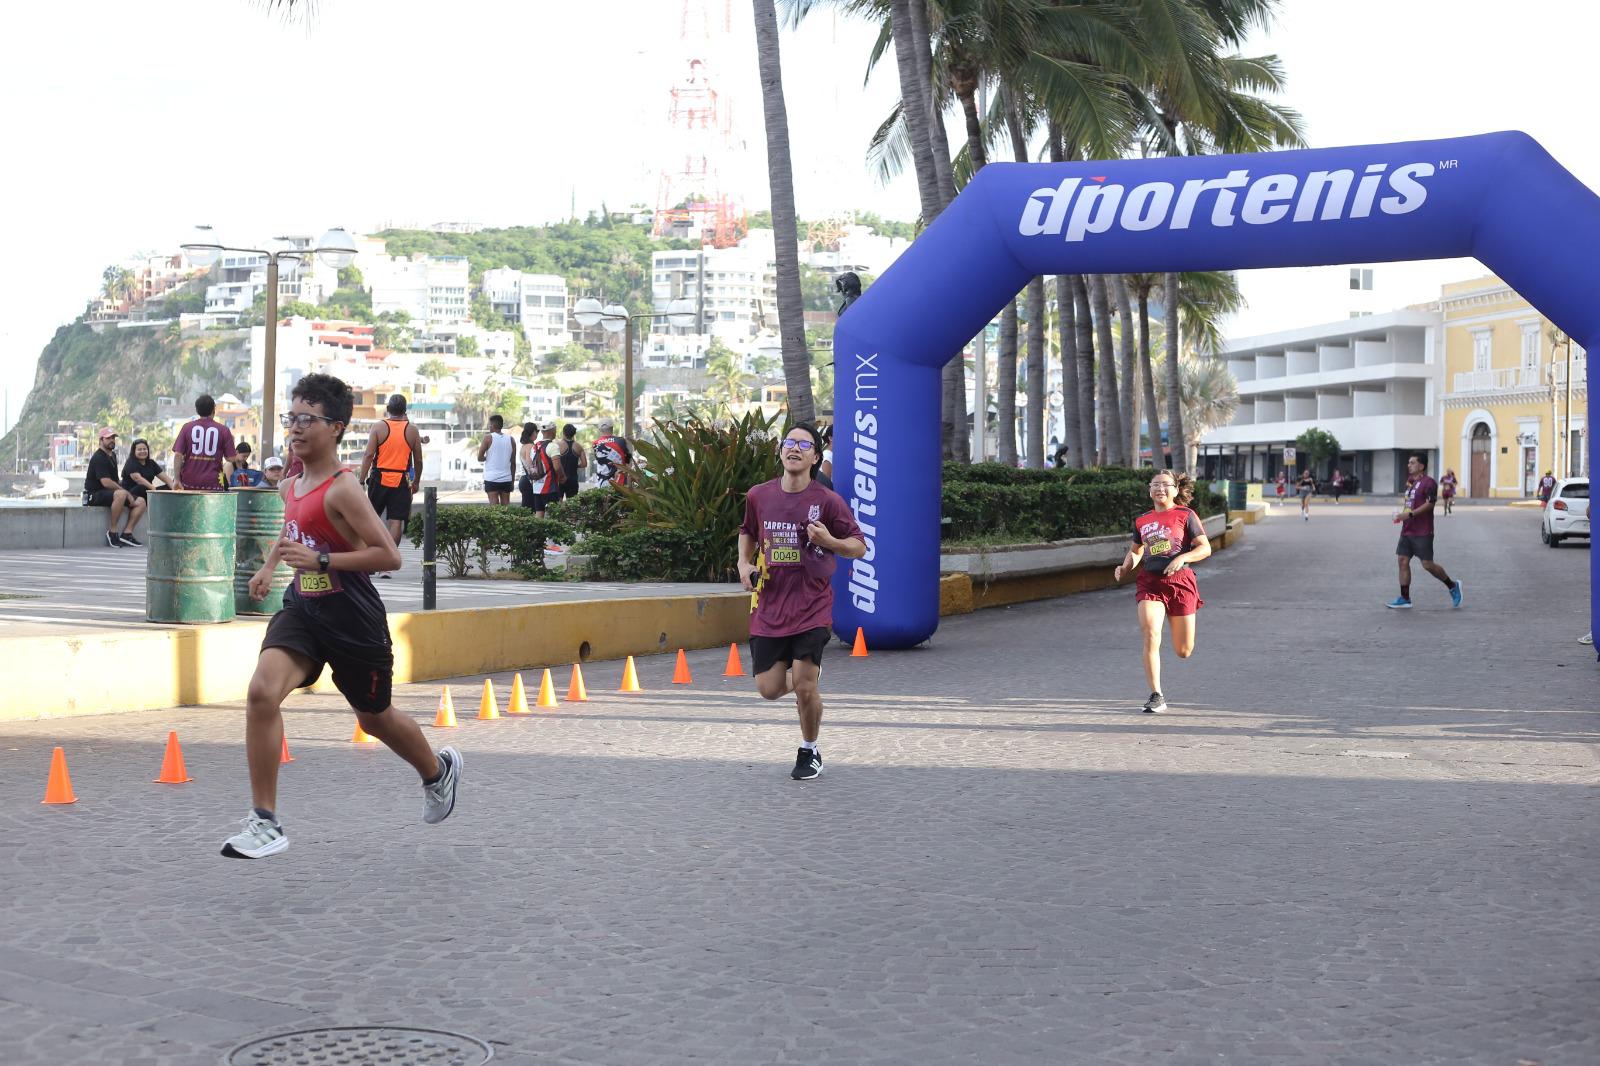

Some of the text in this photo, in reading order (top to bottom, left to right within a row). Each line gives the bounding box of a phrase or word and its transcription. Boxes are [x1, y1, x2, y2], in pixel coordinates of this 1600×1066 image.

[1018, 159, 1458, 242] dportenis MR
[191, 425, 219, 456] 90
[773, 551, 798, 561] 0049
[302, 577, 327, 589] 0295
